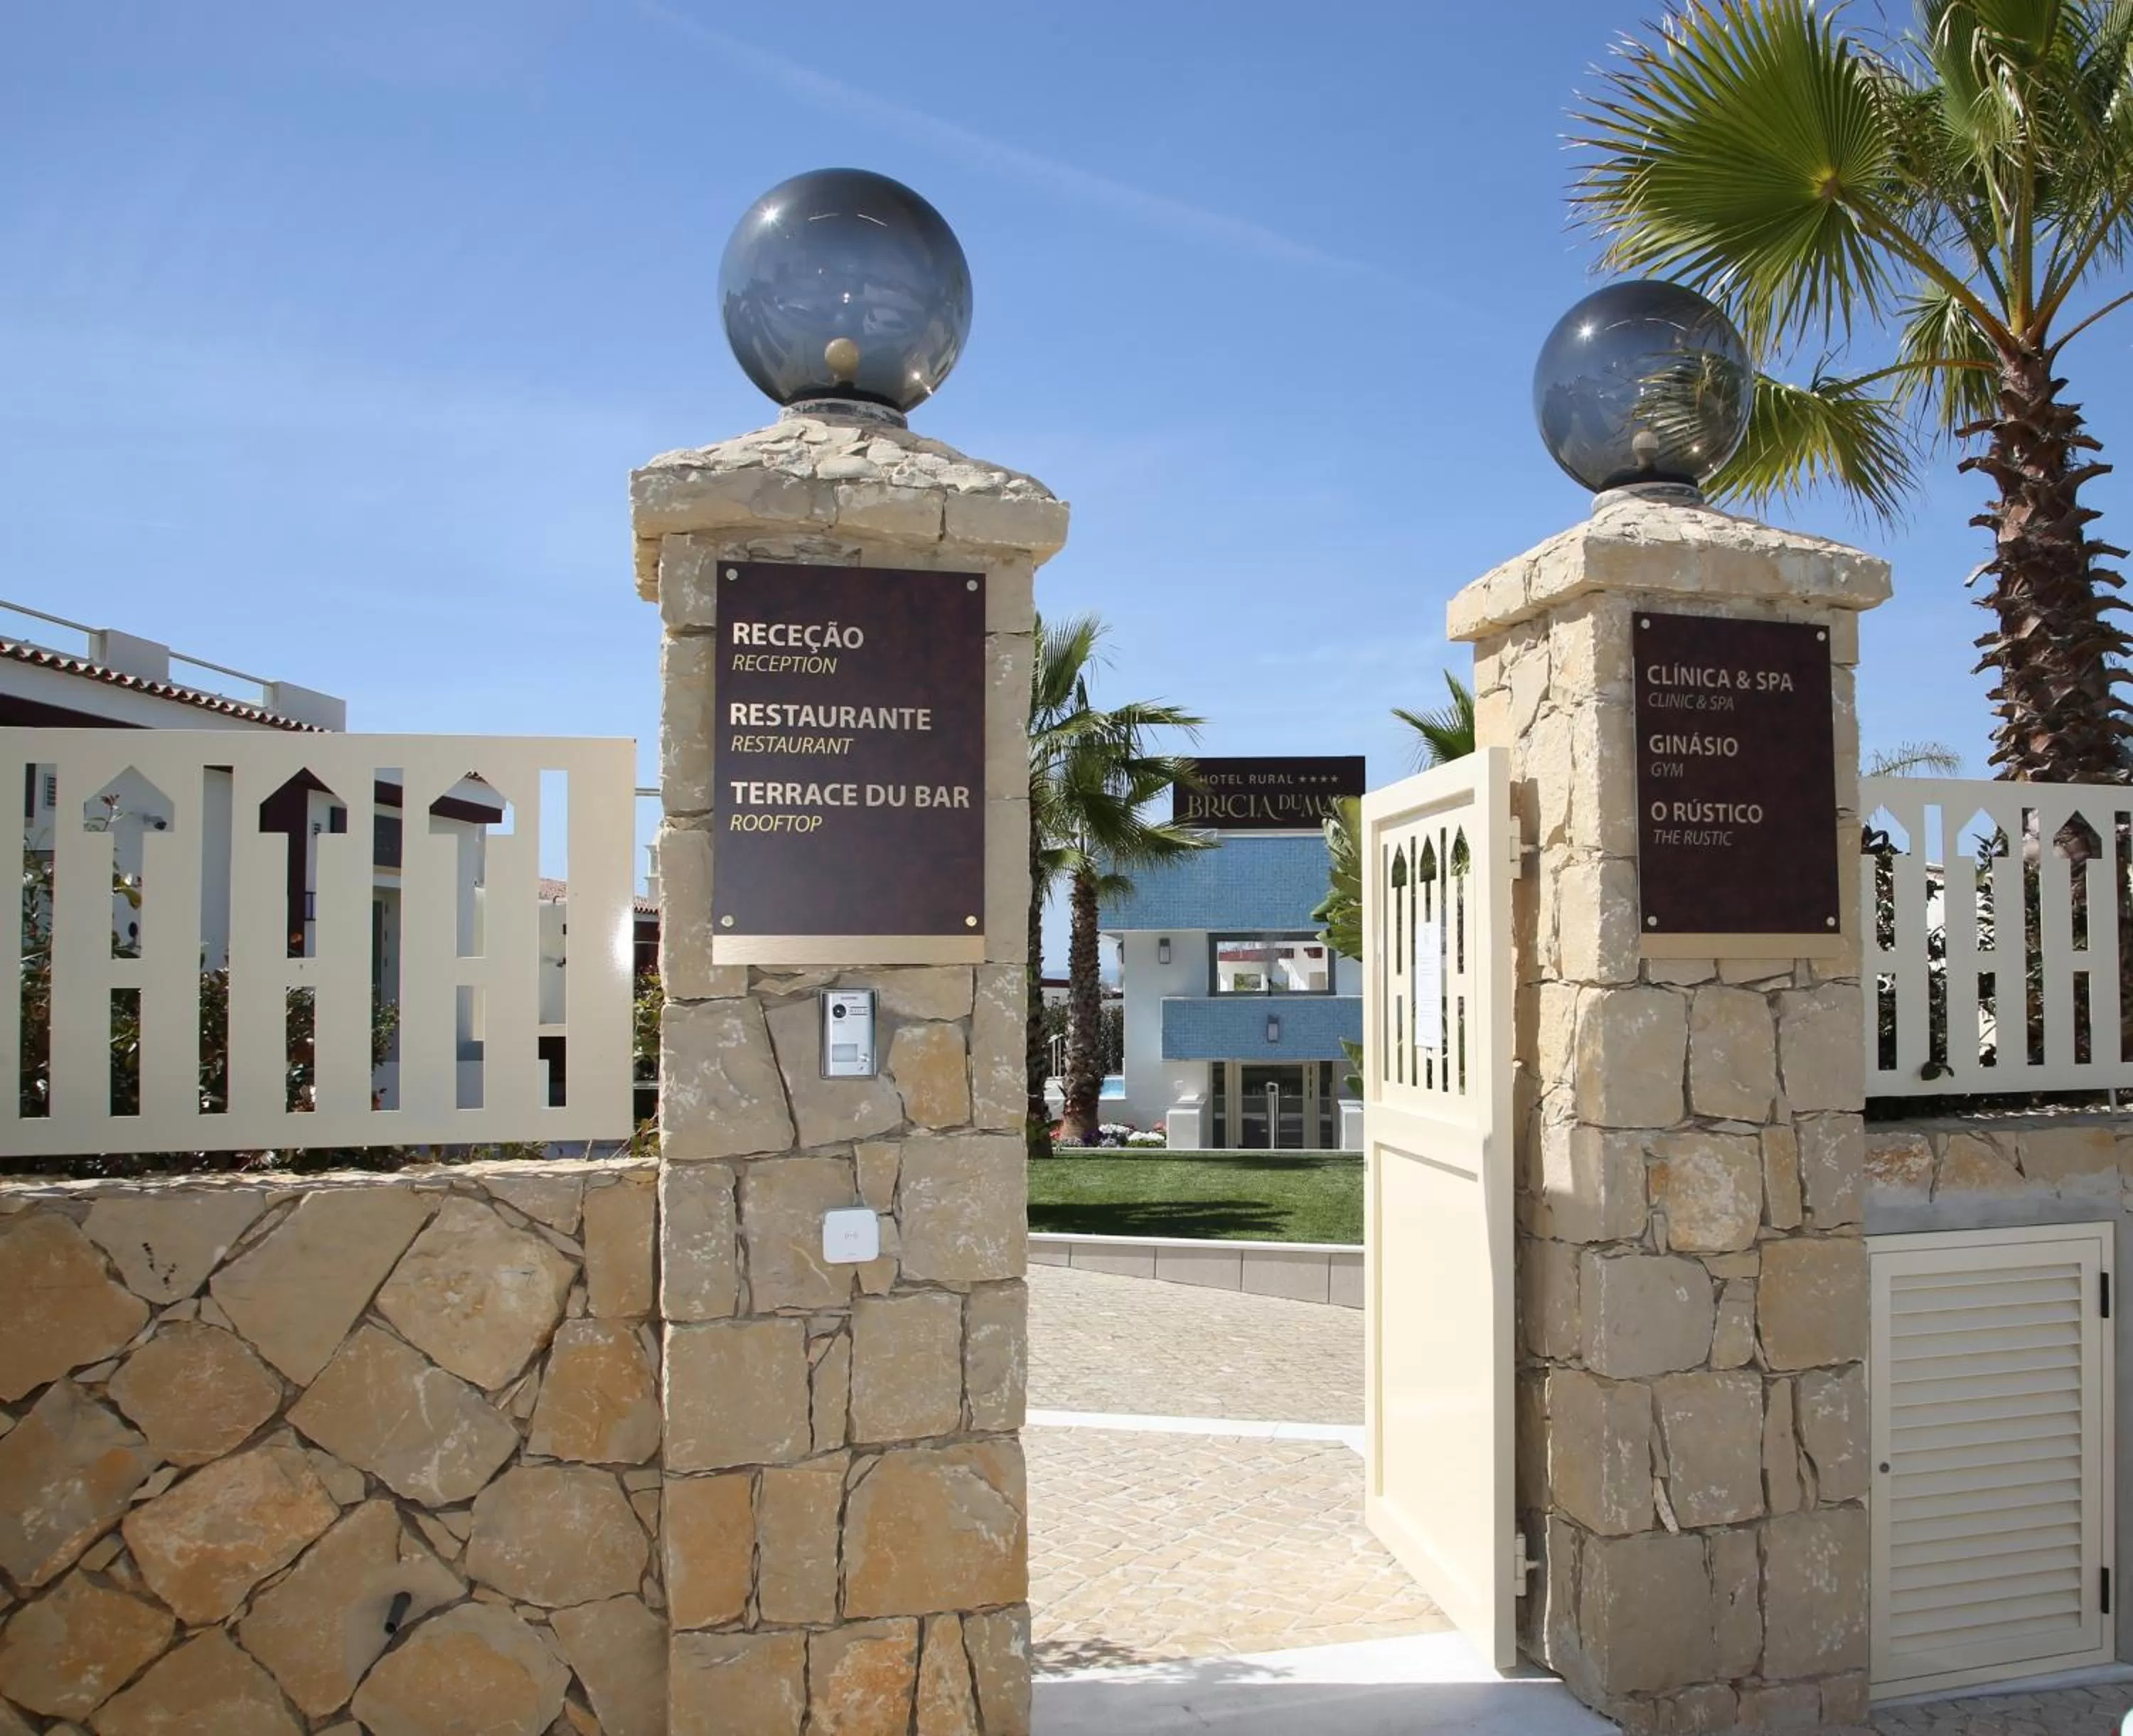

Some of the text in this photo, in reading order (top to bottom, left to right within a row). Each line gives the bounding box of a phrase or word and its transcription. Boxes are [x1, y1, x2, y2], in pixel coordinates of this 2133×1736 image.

[732, 621, 864, 653] RECEÇÃO
[732, 654, 837, 674] RECEPTION
[1647, 663, 1794, 692] CLÍNICA & SPA
[1649, 692, 1735, 712] CLINIC & SPA
[730, 703, 931, 730] RESTAURANTE
[731, 735, 853, 754] RESTAURANT
[1649, 732, 1738, 757] GINÁSIO
[1199, 773, 1294, 786] HOTEL RURAL
[1650, 761, 1684, 778] GYM
[731, 782, 970, 808] TERRACE DU BAR
[1651, 798, 1763, 824] O RÚSTICO
[730, 815, 823, 832] ROOFTOP
[1654, 829, 1733, 846] THE RUSTIC
